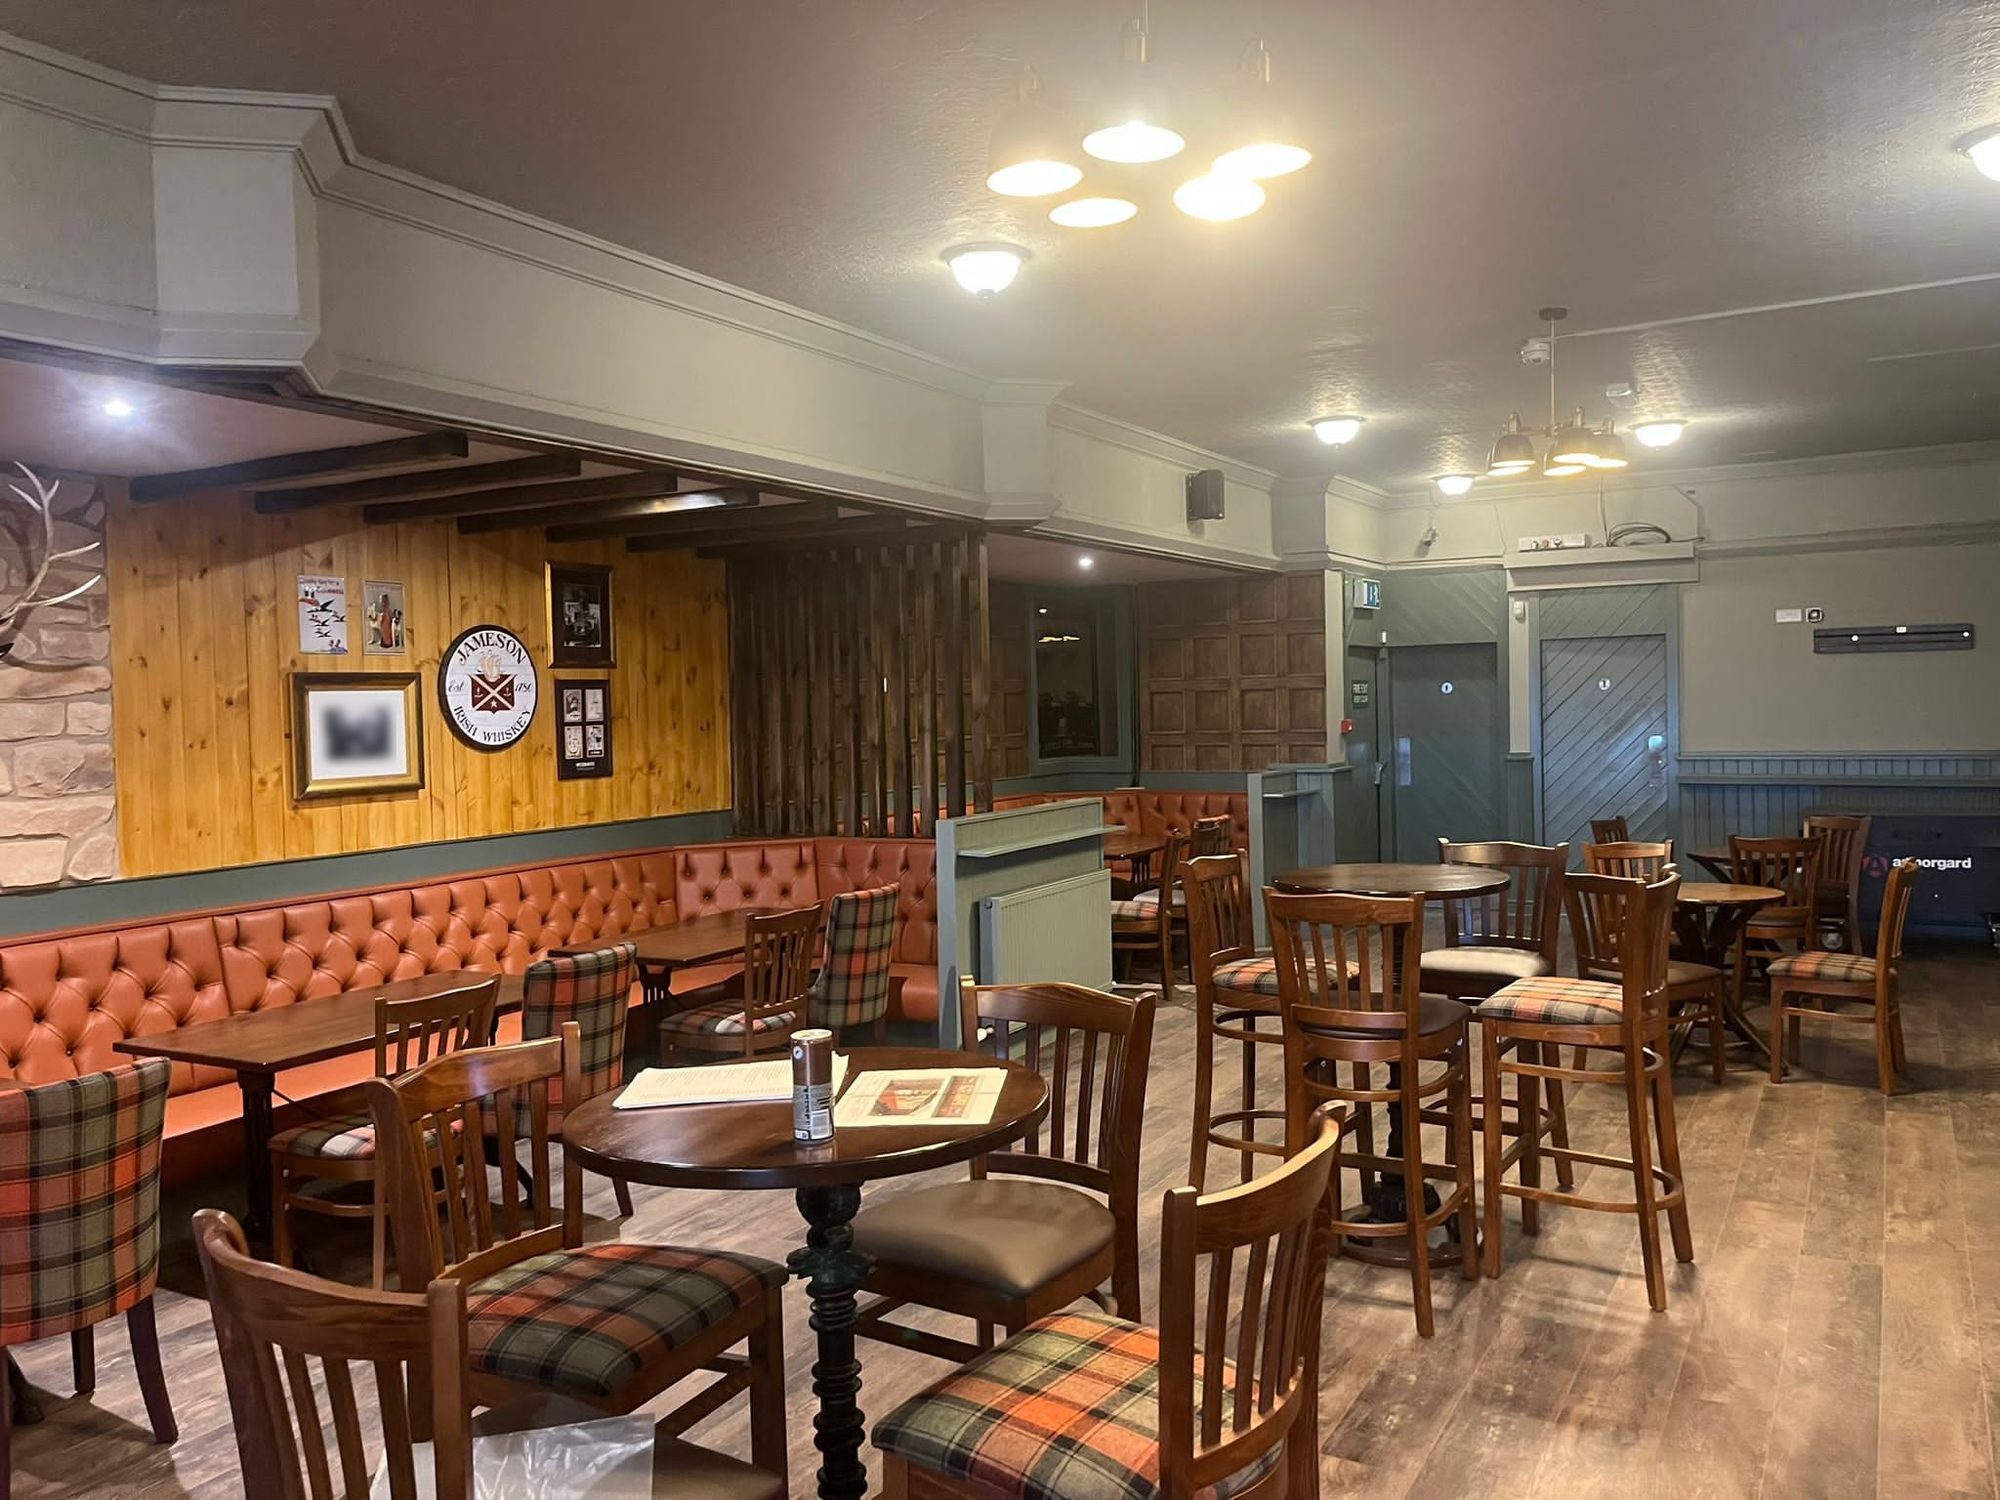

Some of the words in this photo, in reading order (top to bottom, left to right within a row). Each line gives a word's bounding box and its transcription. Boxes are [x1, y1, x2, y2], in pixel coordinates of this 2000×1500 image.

[458, 632, 527, 665] JAMESON
[453, 705, 478, 737] IRISH
[483, 704, 531, 743] WHISKEY
